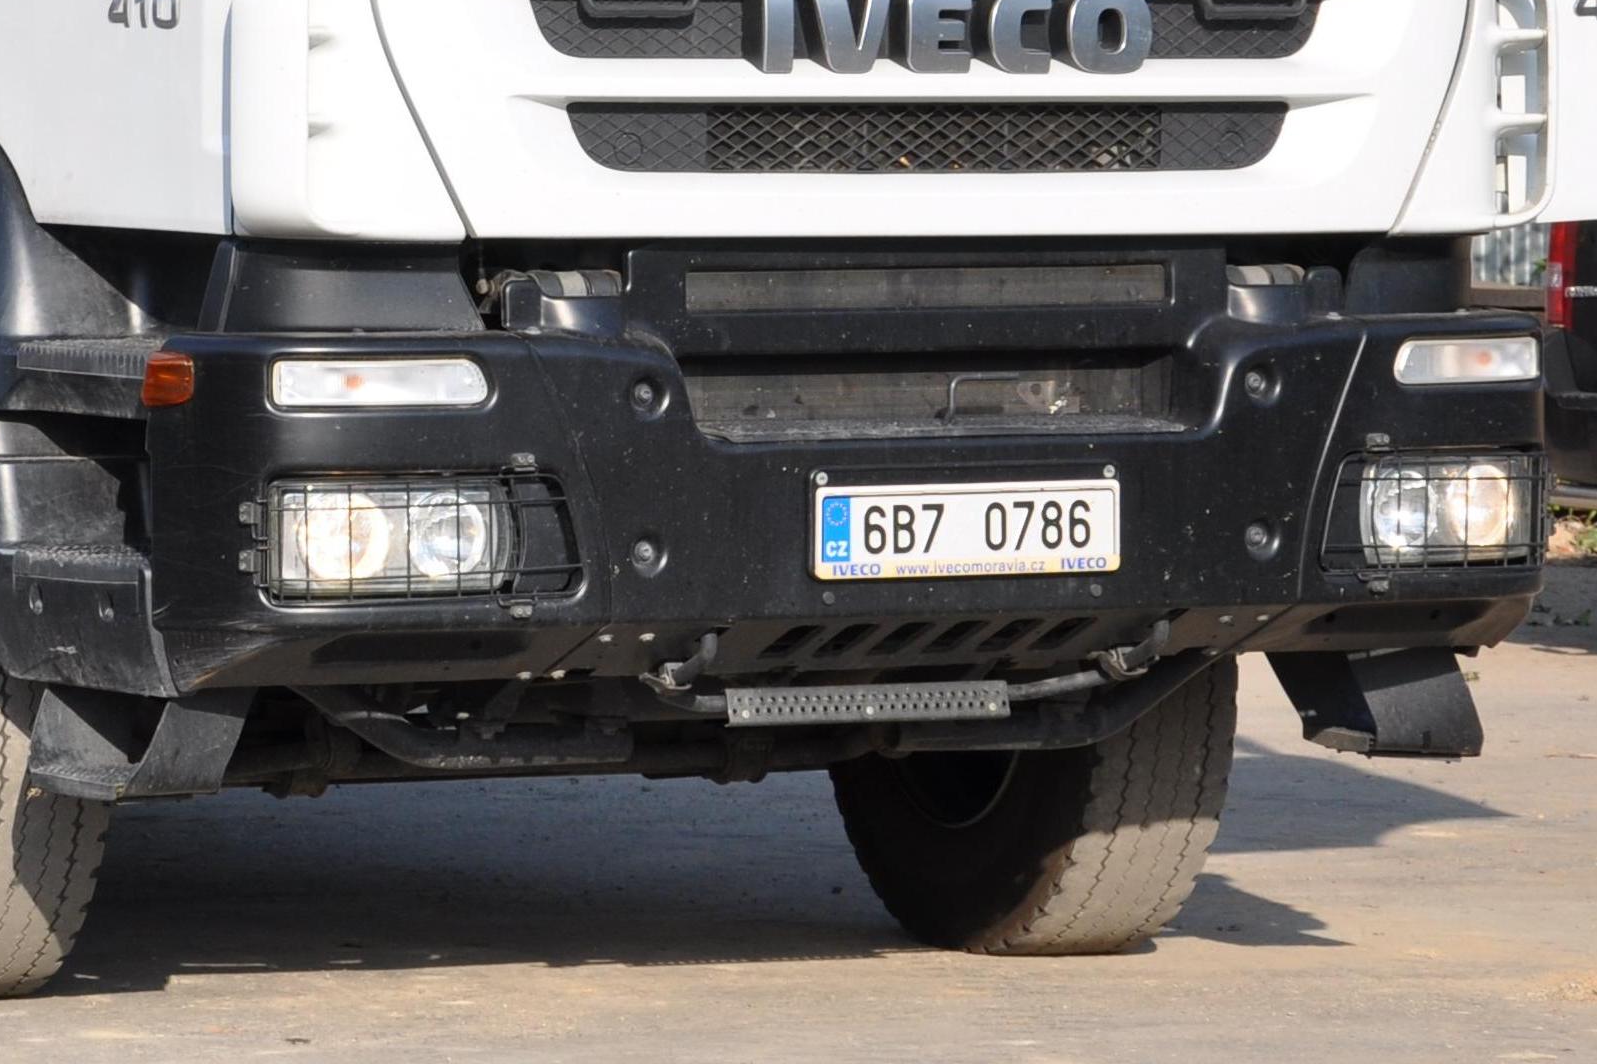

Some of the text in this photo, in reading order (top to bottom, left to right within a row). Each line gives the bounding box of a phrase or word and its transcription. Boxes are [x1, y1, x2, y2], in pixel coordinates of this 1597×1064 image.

[864, 499, 1091, 554] 6B7 0786
[825, 539, 848, 557] CZ
[832, 563, 882, 577] IVECO
[1060, 556, 1107, 570] IVECO
